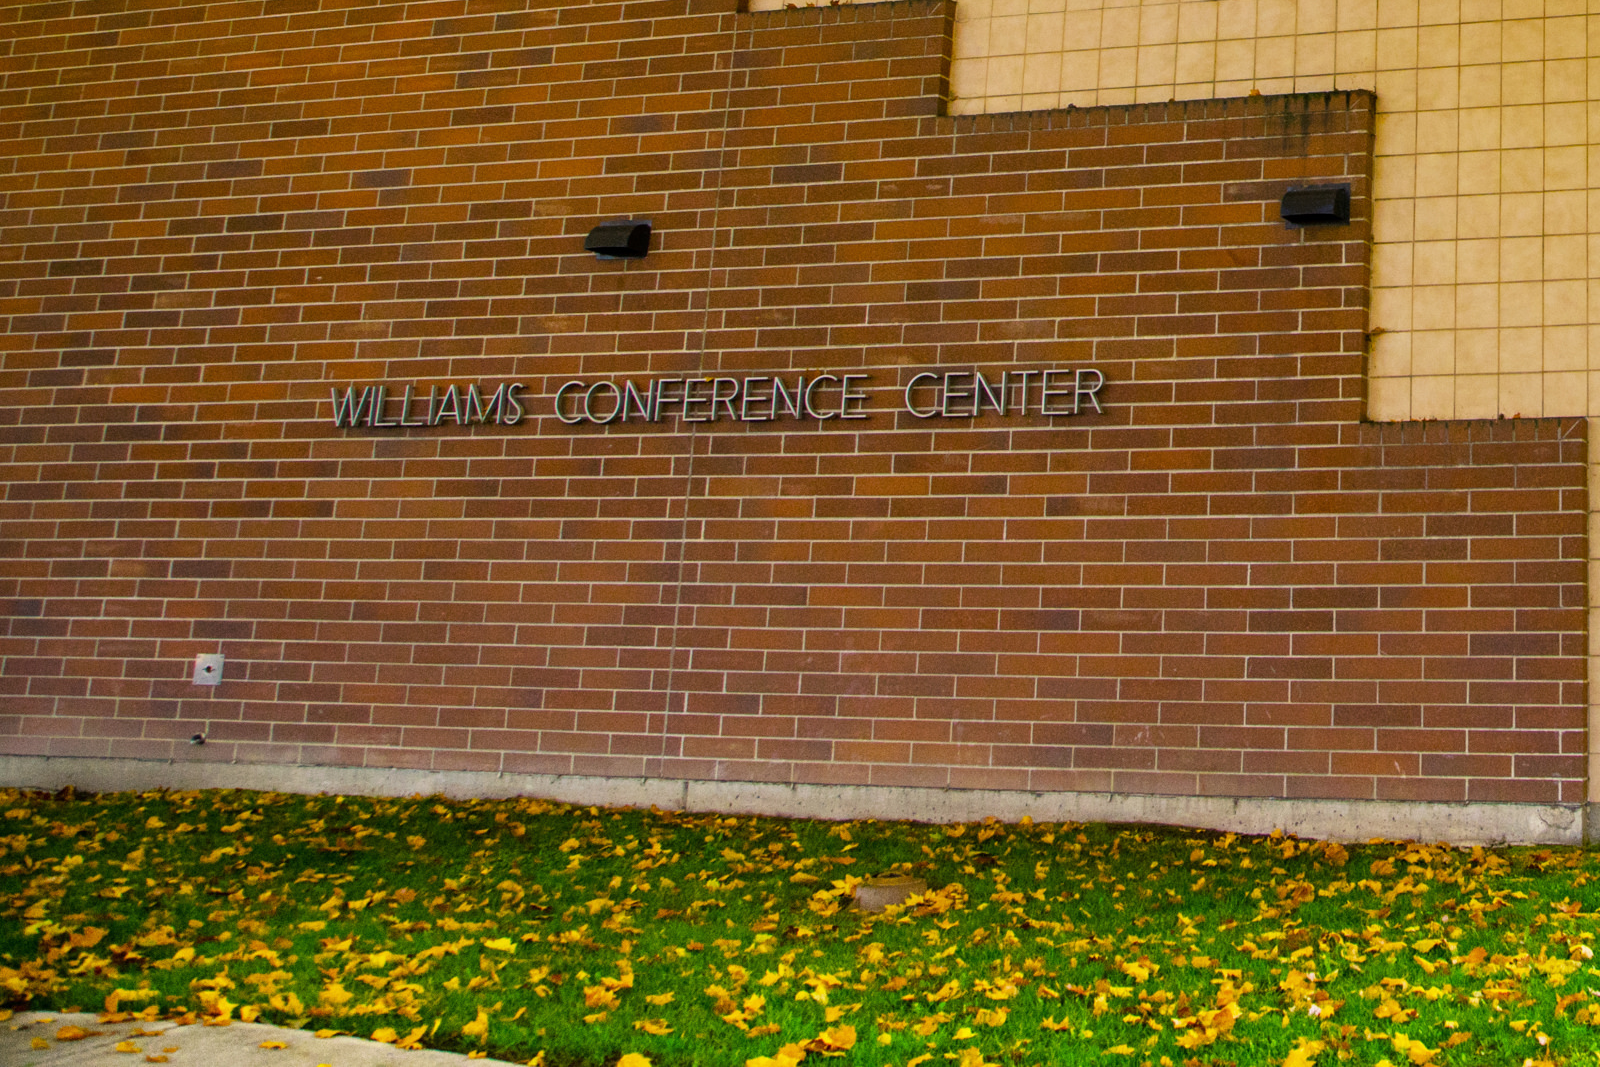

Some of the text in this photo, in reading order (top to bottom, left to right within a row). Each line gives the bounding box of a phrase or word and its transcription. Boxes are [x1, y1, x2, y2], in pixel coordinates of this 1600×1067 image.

[331, 368, 1105, 427] WILLIAMS CONFERENCE CENTER
